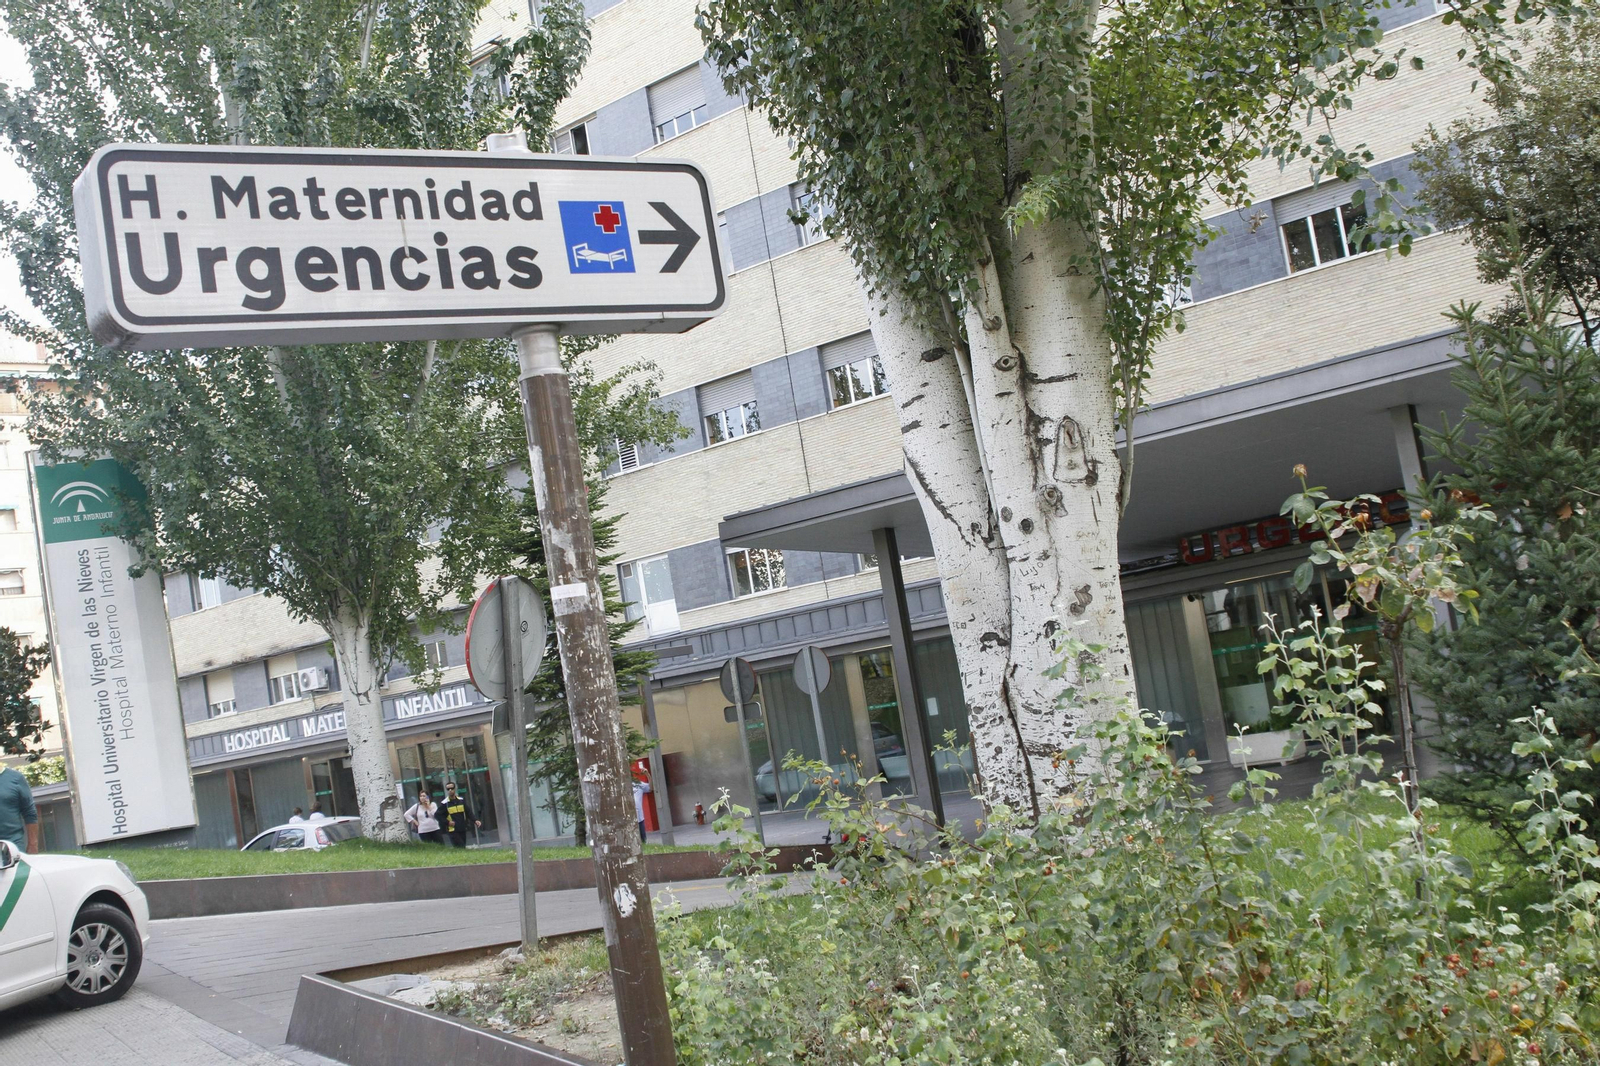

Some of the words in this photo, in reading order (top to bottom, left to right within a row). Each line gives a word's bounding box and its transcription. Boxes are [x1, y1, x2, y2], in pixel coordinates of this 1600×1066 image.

[117, 174, 188, 221] H.
[211, 174, 544, 222] Maternidad
[126, 231, 544, 311] Urgencias
[52, 516, 71, 525] JUNTA
[77, 548, 94, 593] Nieves
[93, 546, 115, 598] Infantil
[81, 597, 97, 617] las
[84, 621, 100, 638] de
[106, 604, 125, 669] Materno
[90, 642, 108, 686] Virgen
[94, 689, 120, 775] Universitario
[111, 676, 135, 741] Hospital
[224, 724, 291, 753] HOSPITAL
[302, 711, 347, 738] MATE
[395, 687, 473, 720] INFANTIL
[105, 779, 128, 835] Hospital
